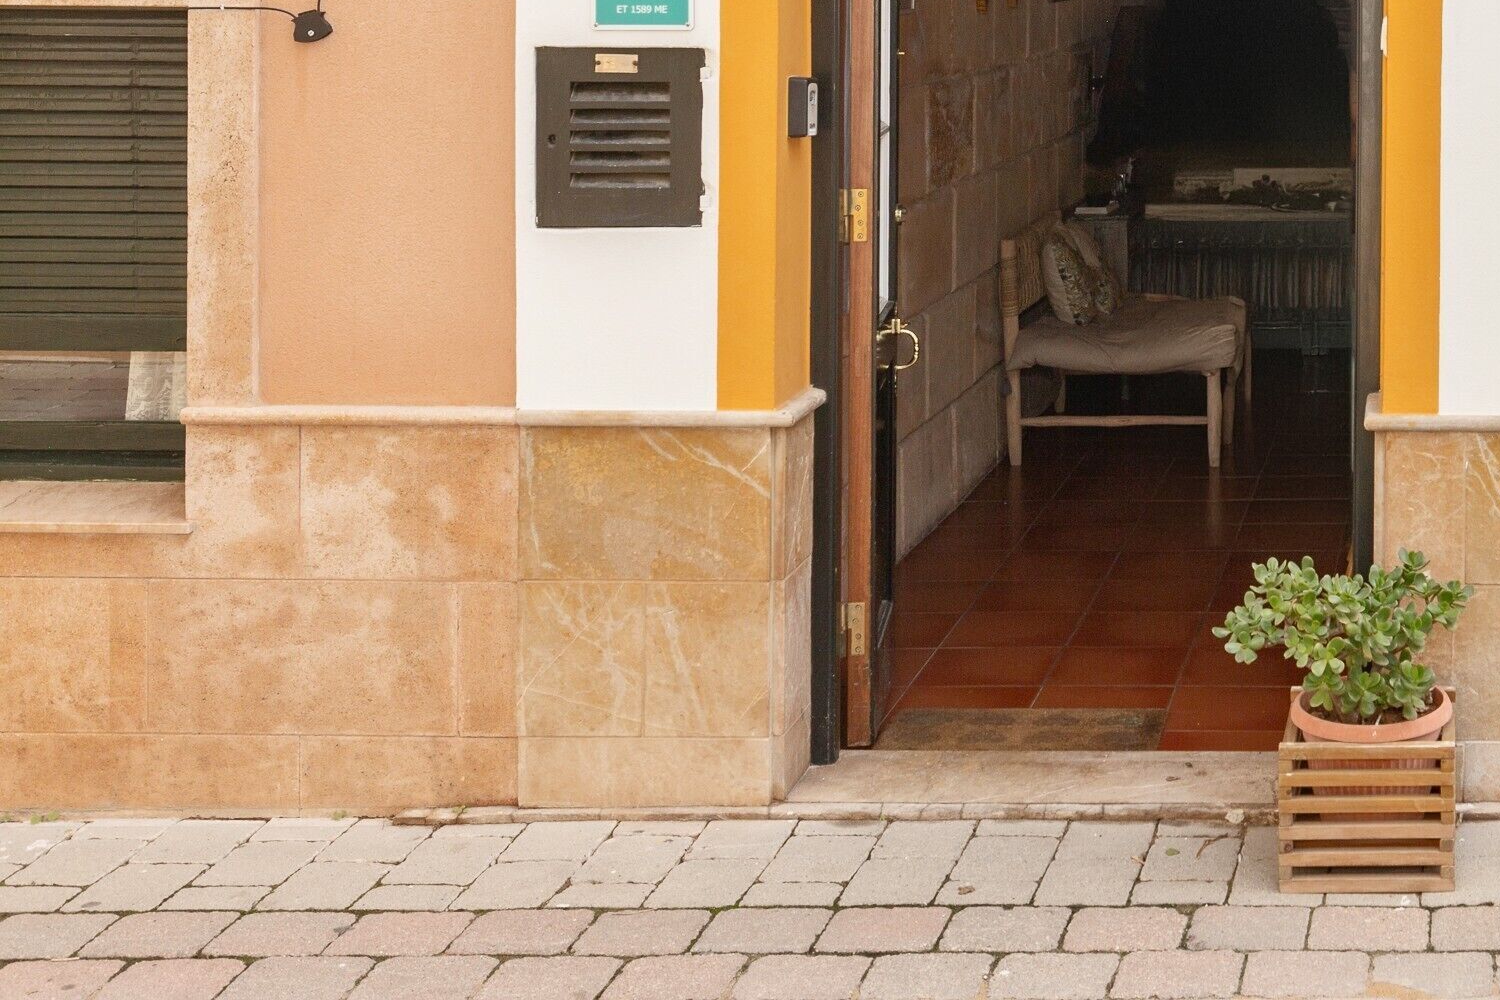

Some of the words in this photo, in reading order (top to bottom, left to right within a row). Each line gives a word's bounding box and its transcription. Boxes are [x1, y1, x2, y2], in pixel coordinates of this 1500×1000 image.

[616, 4, 629, 14] ET
[631, 4, 652, 14] 1589
[654, 4, 668, 14] ME
